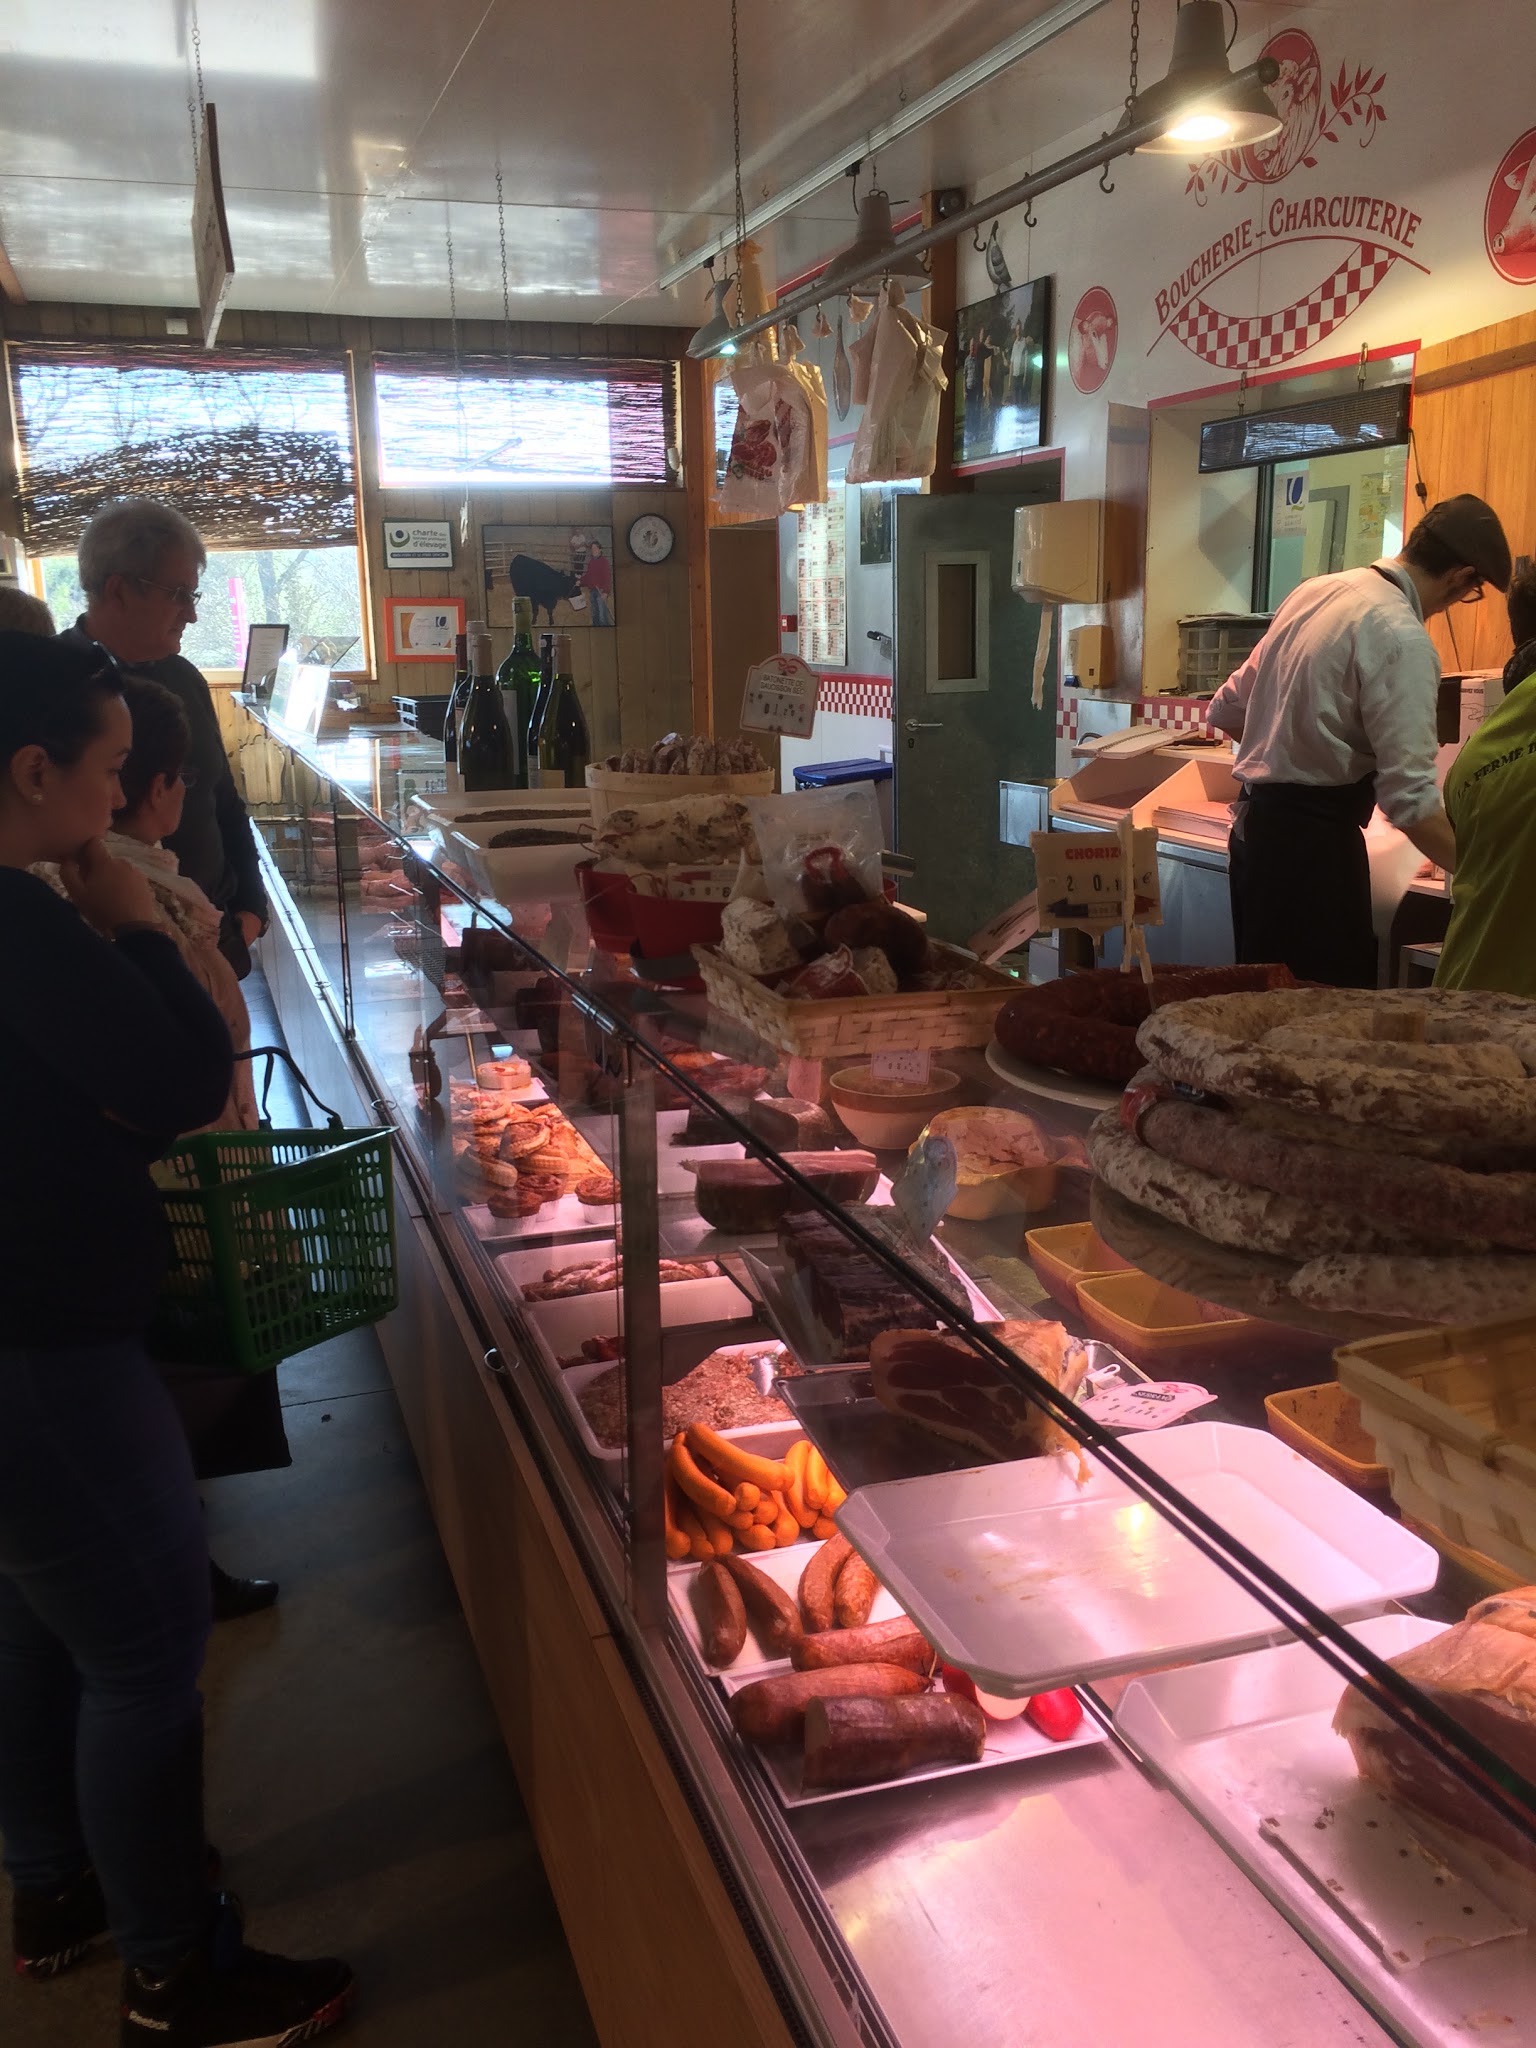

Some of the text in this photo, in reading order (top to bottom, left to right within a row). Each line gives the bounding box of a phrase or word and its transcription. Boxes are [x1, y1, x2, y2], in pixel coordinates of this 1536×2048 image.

[1154, 218, 1252, 326] BOUCHERIE
[1269, 196, 1422, 249] CHARCUTERIE
[1065, 847, 1122, 859] CHORIZ
